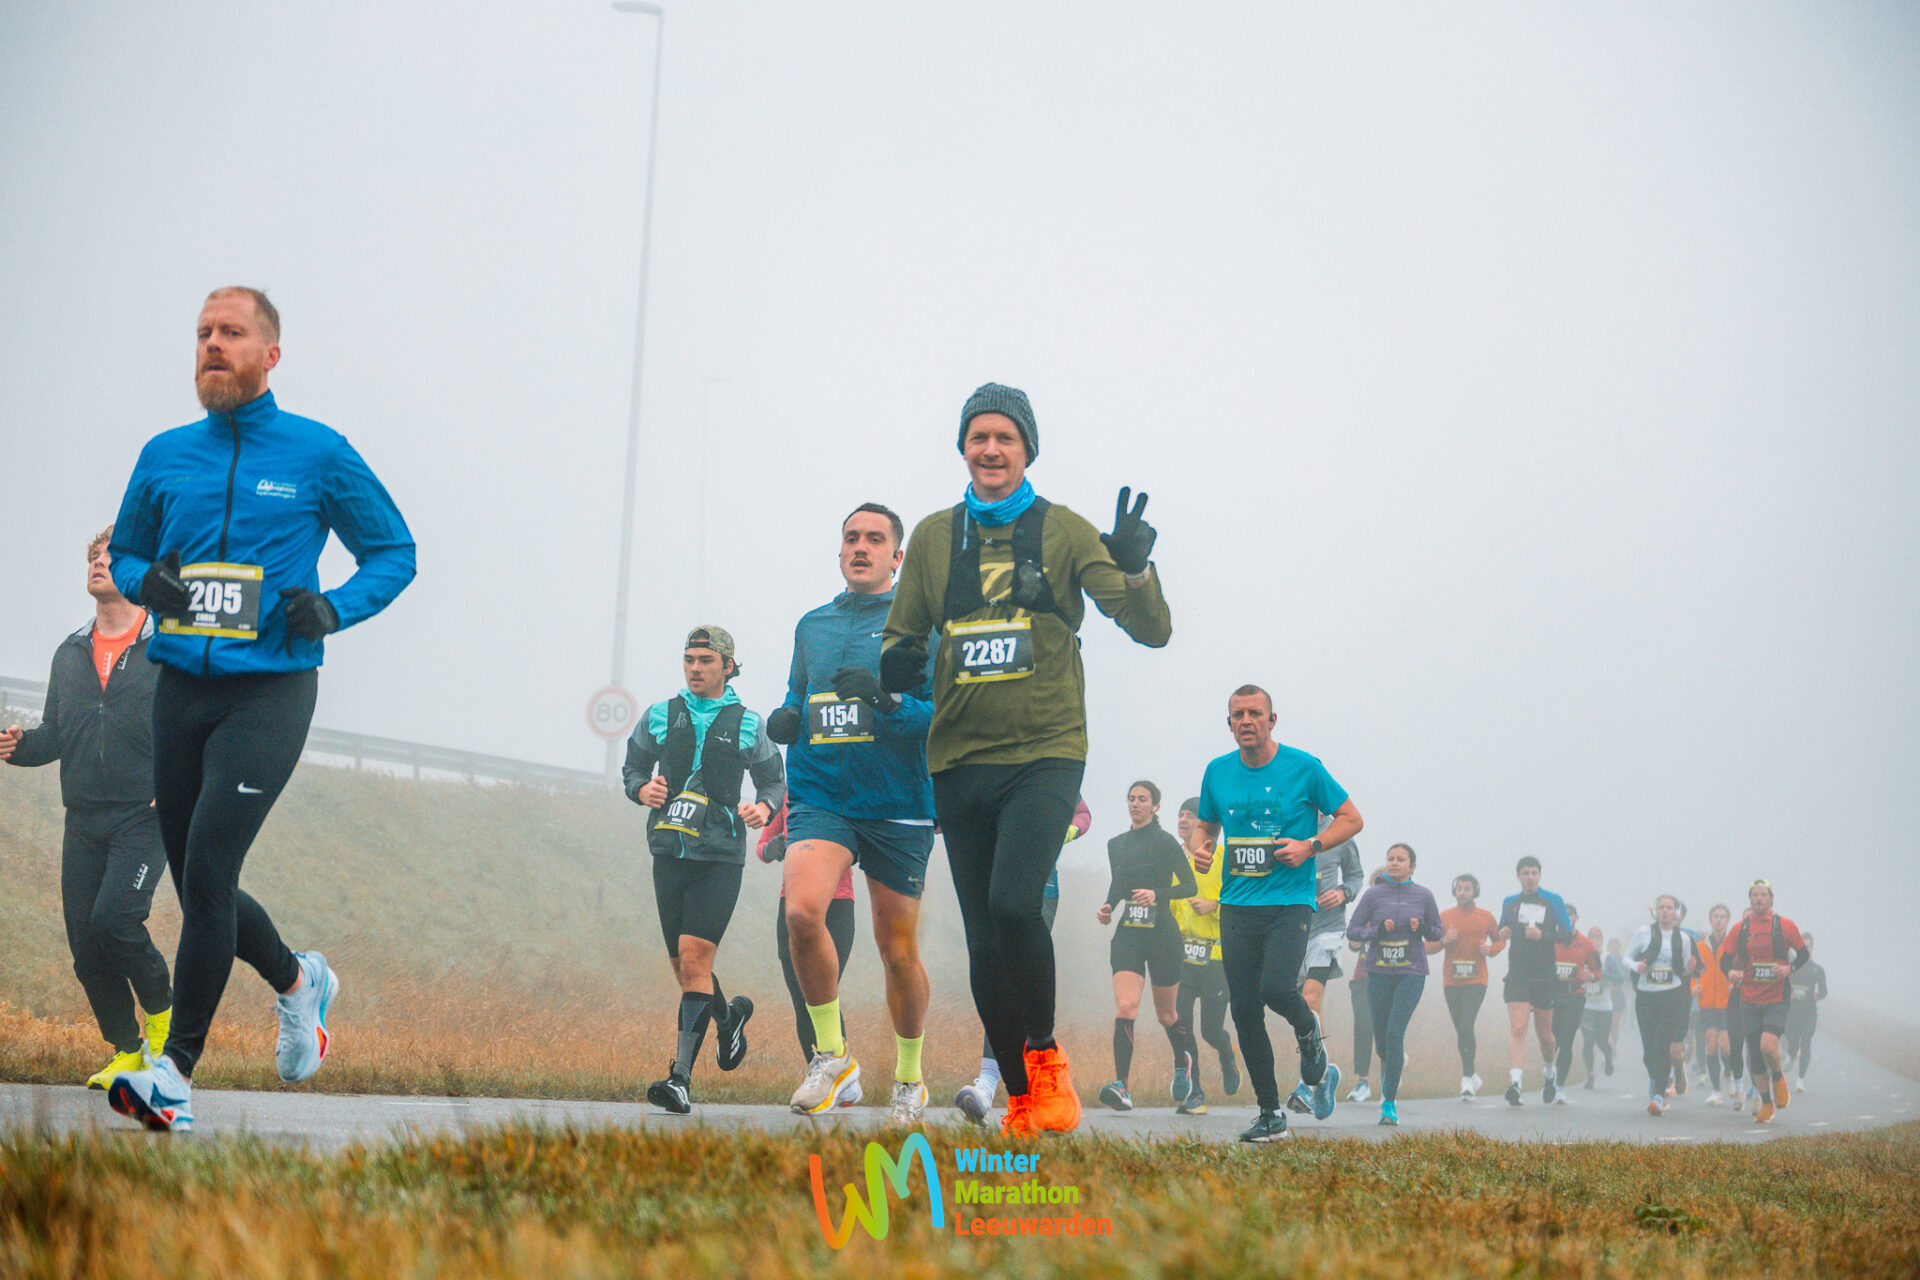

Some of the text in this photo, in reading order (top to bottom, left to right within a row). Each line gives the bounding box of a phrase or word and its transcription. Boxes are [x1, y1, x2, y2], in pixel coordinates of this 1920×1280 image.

[183, 580, 242, 615] 205
[962, 637, 1017, 667] 2287
[596, 702, 628, 722] 80
[820, 704, 859, 727] 1154
[667, 801, 697, 820] 1017
[1234, 847, 1266, 865] 1760
[1128, 906, 1149, 919] 1491
[1184, 943, 1206, 958] 1309
[1381, 947, 1405, 959] 1028
